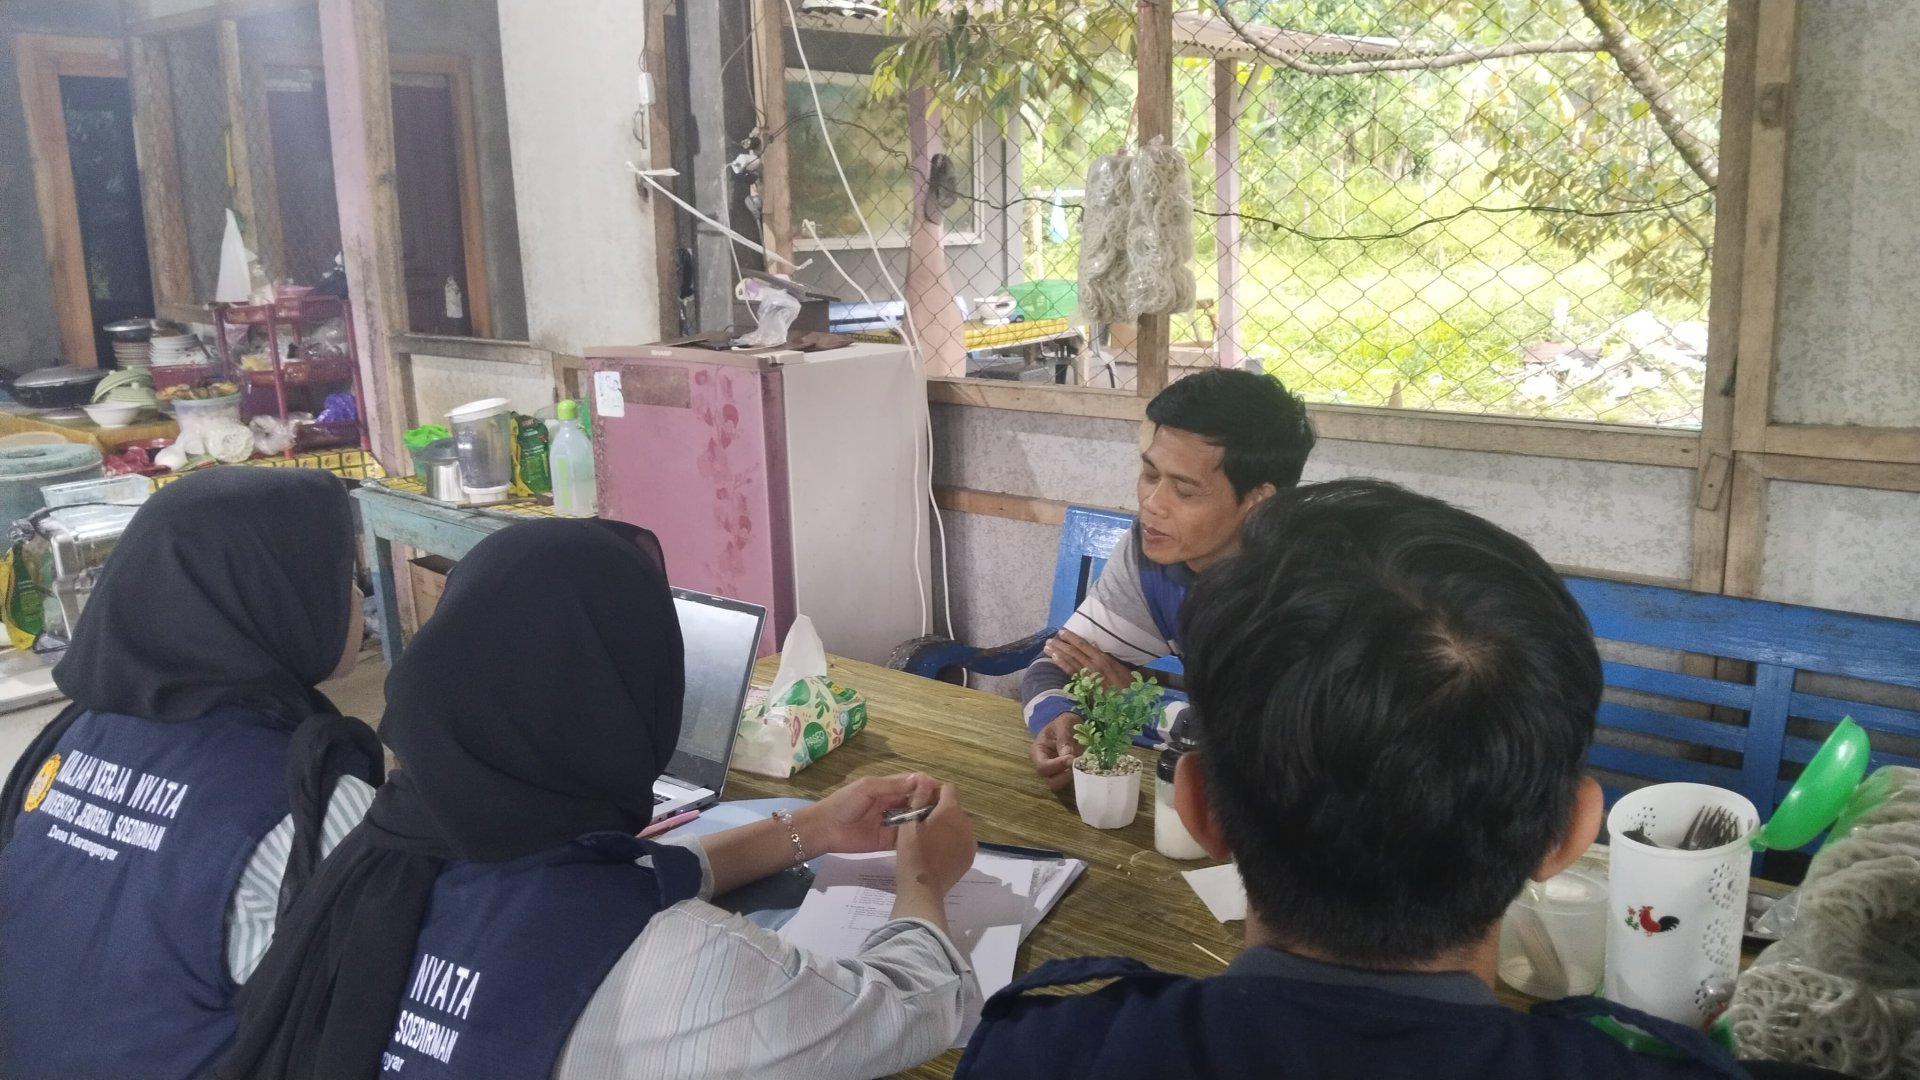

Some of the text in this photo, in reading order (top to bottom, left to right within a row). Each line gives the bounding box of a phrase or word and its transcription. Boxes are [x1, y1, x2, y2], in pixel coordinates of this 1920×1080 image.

[87, 760, 131, 803] KERJA
[127, 773, 188, 819] NYATA
[47, 824, 119, 862] Desa Karanganyar
[111, 814, 167, 853] SOEDIRMAN
[410, 953, 480, 1020] NYATA
[394, 1010, 459, 1064] SOEDIRMAN
